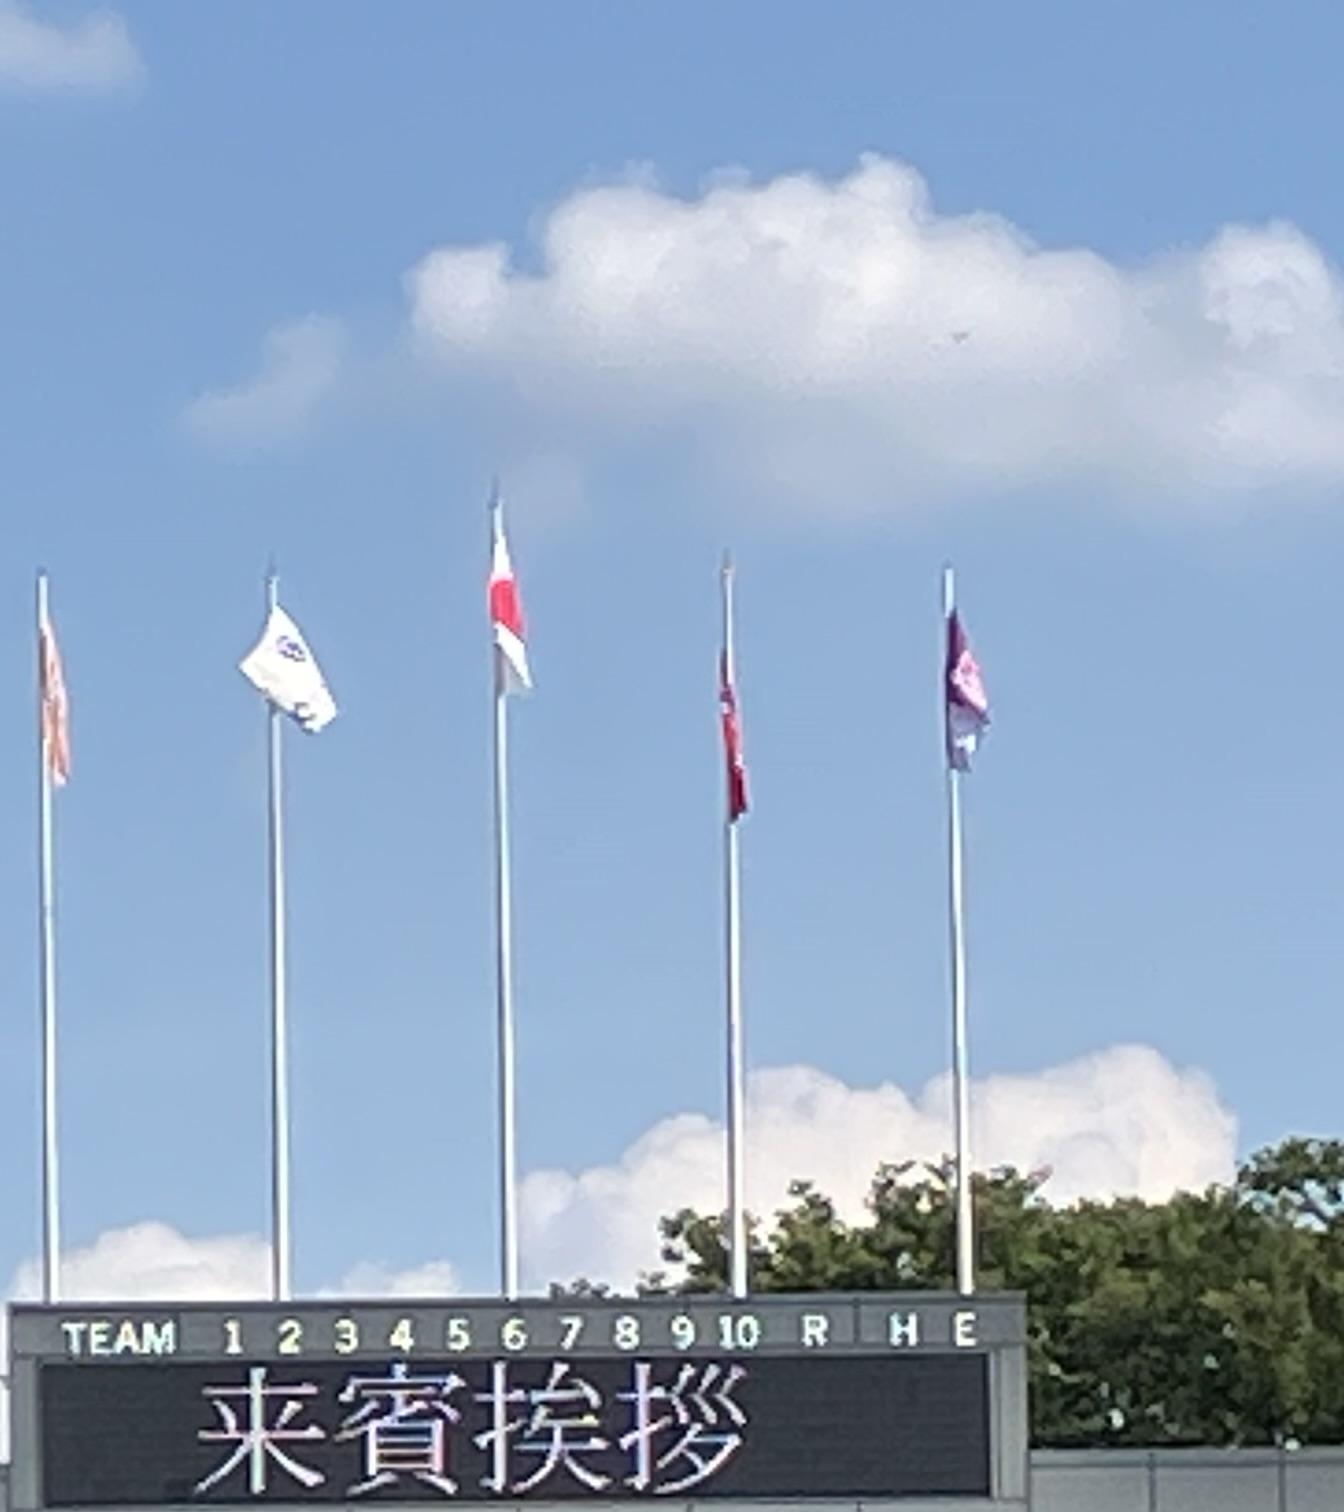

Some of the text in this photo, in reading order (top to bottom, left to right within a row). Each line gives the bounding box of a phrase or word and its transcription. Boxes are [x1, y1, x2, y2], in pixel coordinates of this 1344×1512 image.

[61, 1312, 977, 1355] TEAM 1 2 3 4 5 6 7 8 9 10 R H E
[194, 1362, 749, 1496] 来賓挨拶
